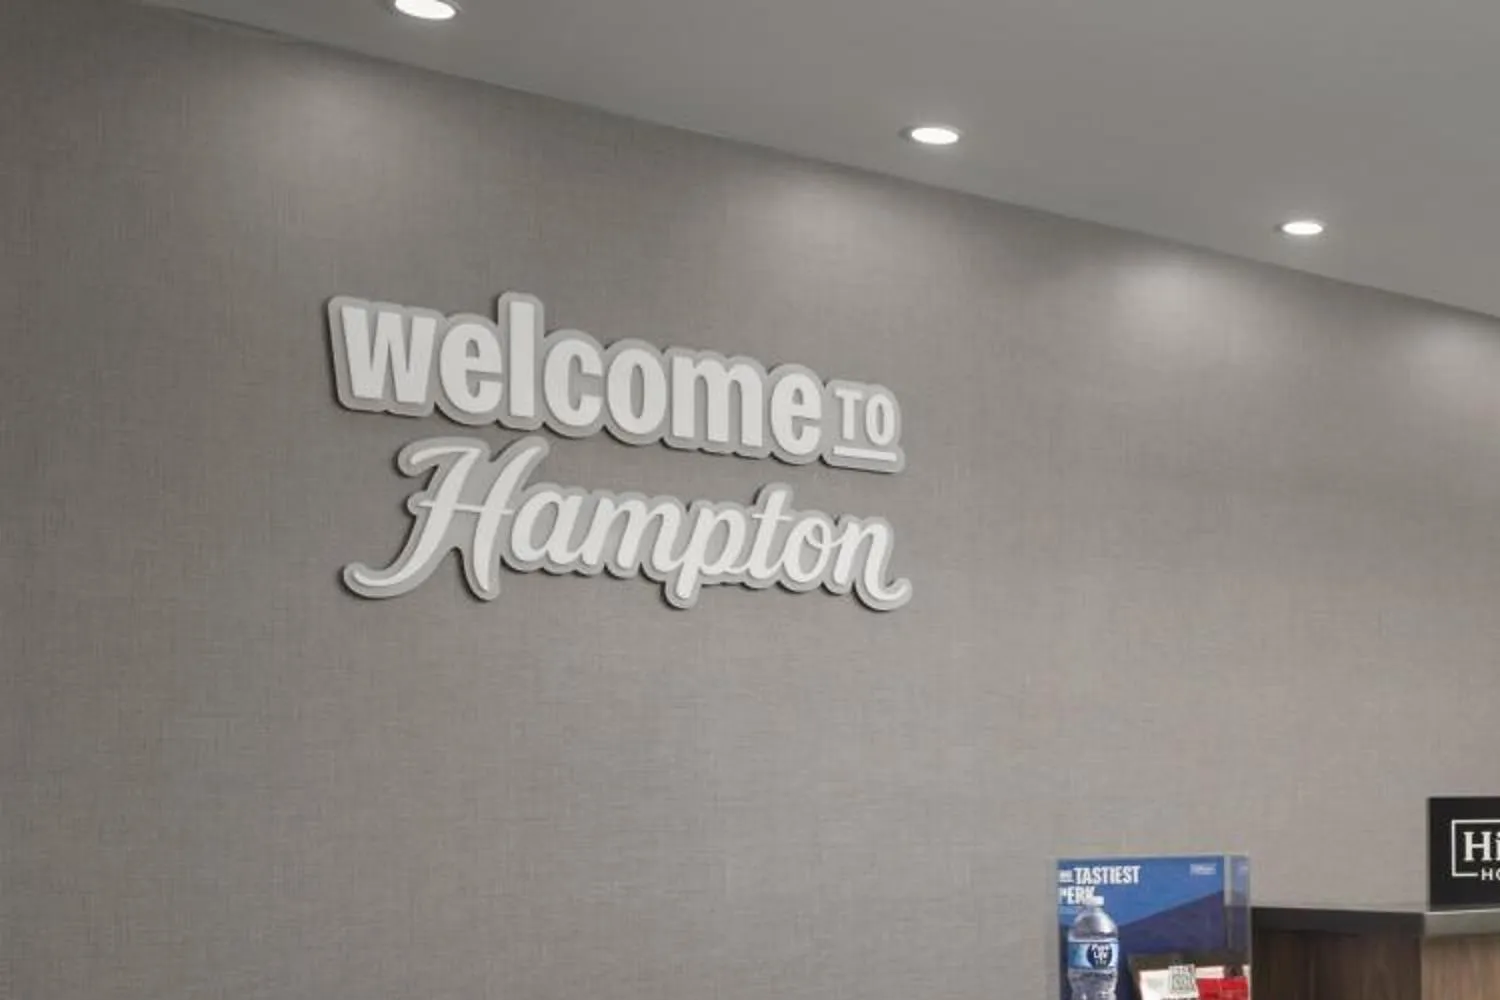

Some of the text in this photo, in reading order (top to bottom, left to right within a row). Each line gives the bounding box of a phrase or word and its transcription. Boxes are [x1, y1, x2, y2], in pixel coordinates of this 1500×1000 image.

[338, 299, 896, 456] welcome TO
[350, 446, 911, 600] Hampton
[1073, 865, 1141, 885] TASTIEST
